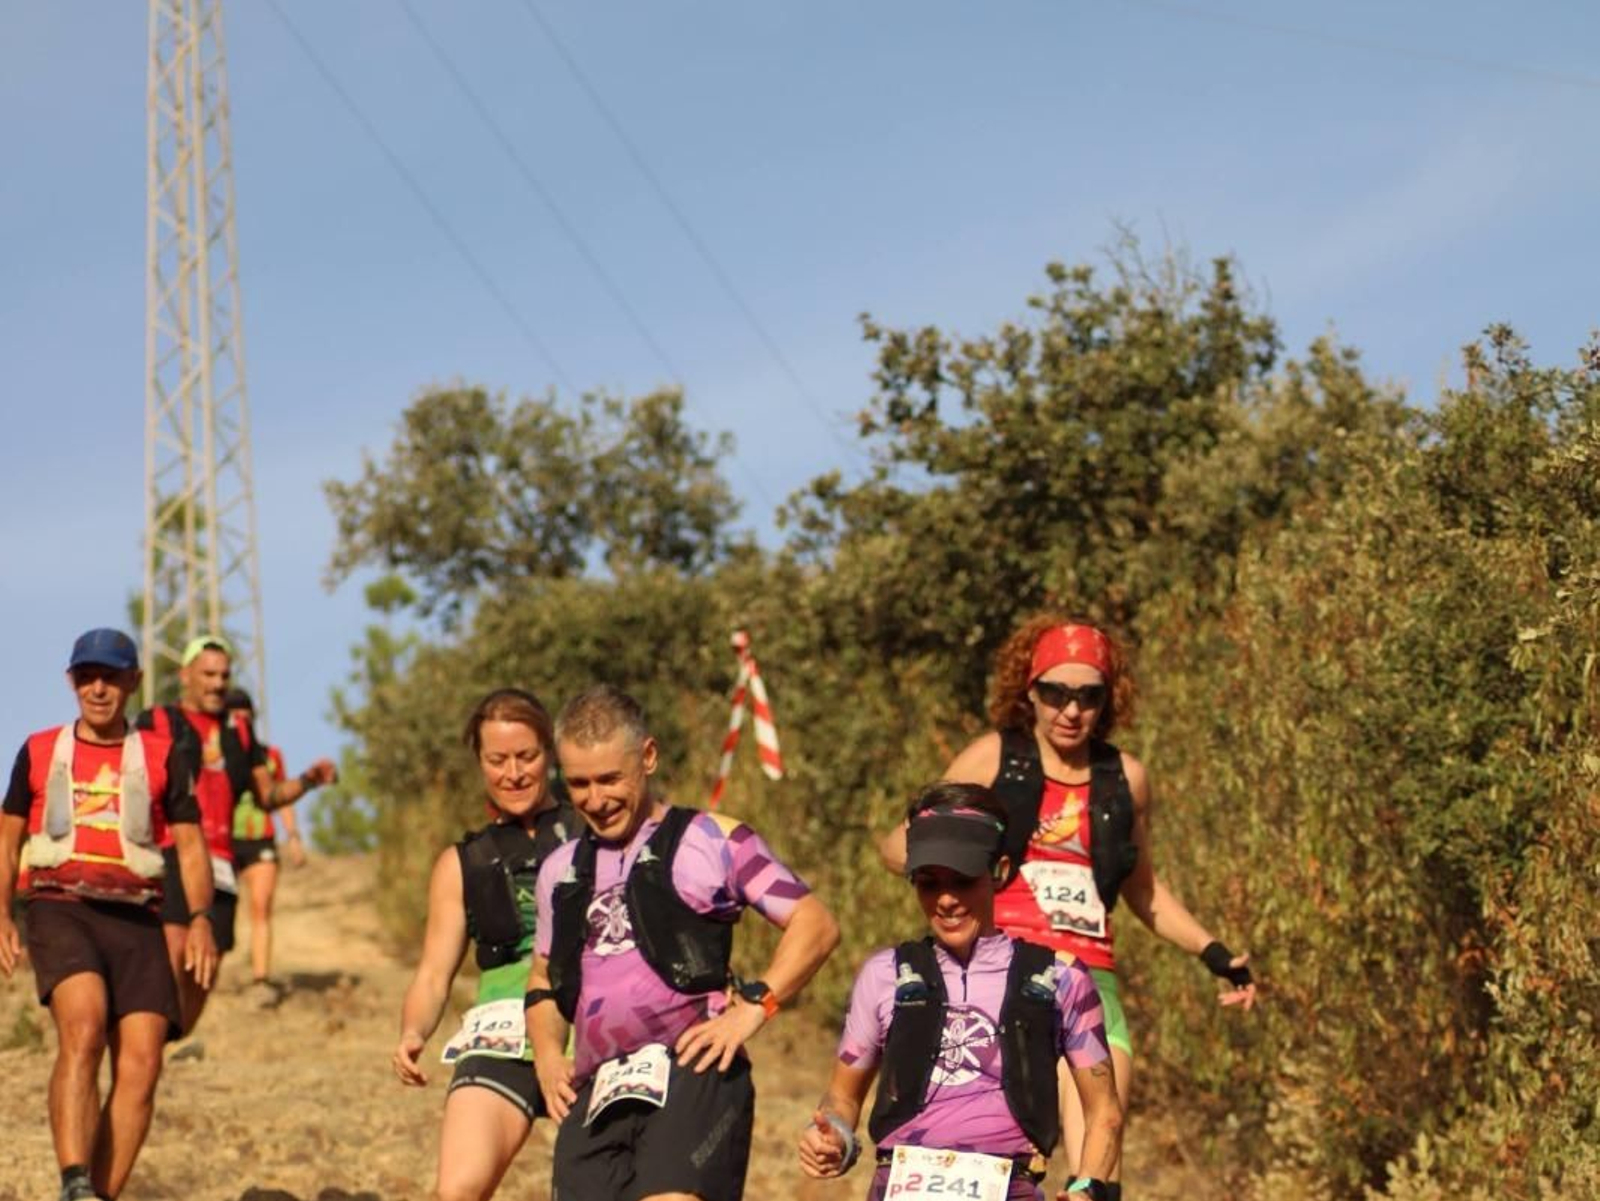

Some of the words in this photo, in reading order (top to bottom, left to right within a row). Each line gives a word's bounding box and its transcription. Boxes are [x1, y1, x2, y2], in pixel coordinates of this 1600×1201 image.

[1043, 886, 1086, 905] 124
[470, 1020, 513, 1033] 140
[608, 1062, 653, 1085] 242
[926, 1174, 982, 1199] 241
